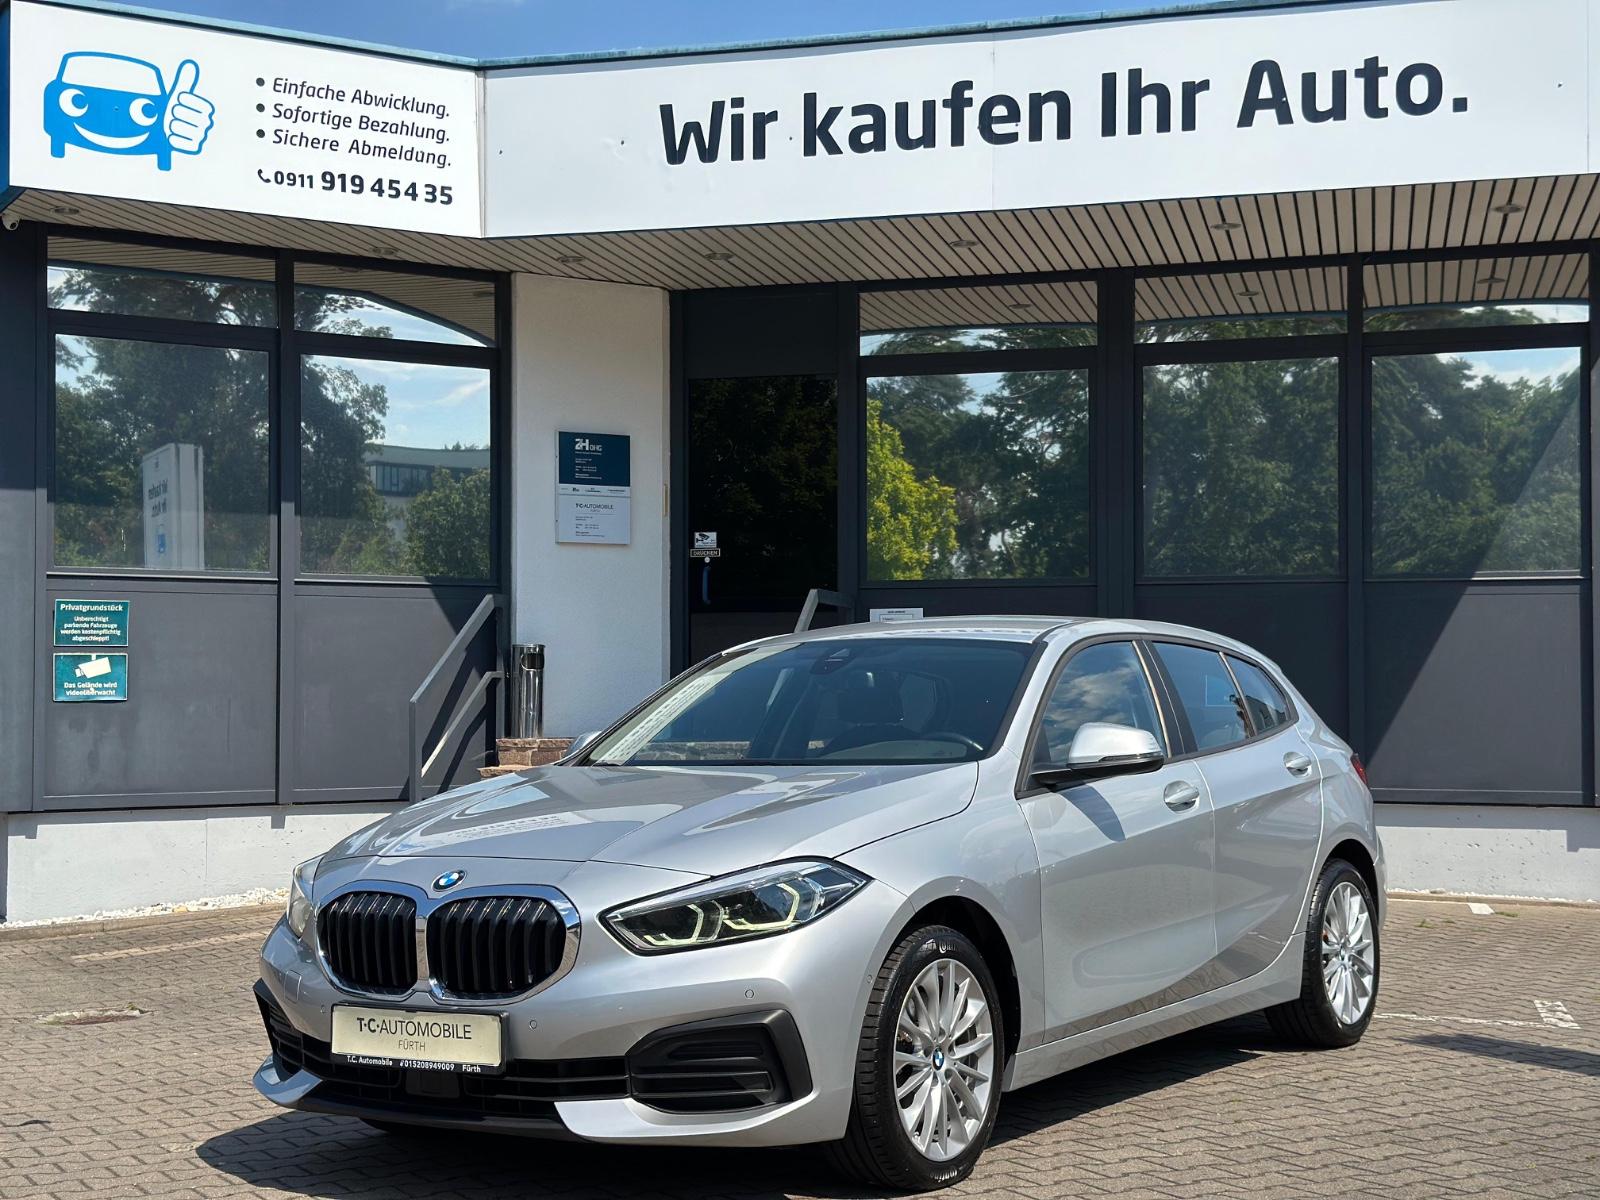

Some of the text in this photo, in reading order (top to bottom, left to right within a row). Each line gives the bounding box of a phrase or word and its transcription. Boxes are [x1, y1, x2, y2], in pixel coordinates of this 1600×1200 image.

[273, 77, 450, 119] Einfache Abwicklung.
[660, 56, 1468, 165] Wir kaufen Ihr Auto.
[272, 103, 450, 144] Sofortige Bezahlung.
[272, 129, 451, 169] Sichere Abmeldung.
[274, 170, 453, 205] 0911 919 454 35
[60, 603, 123, 612] Privatgrundstück
[398, 1038, 426, 1052] FÜRTH
[347, 1055, 358, 1063] T.C.
[358, 1056, 393, 1067] Automobile
[462, 1064, 481, 1073] Fürth
